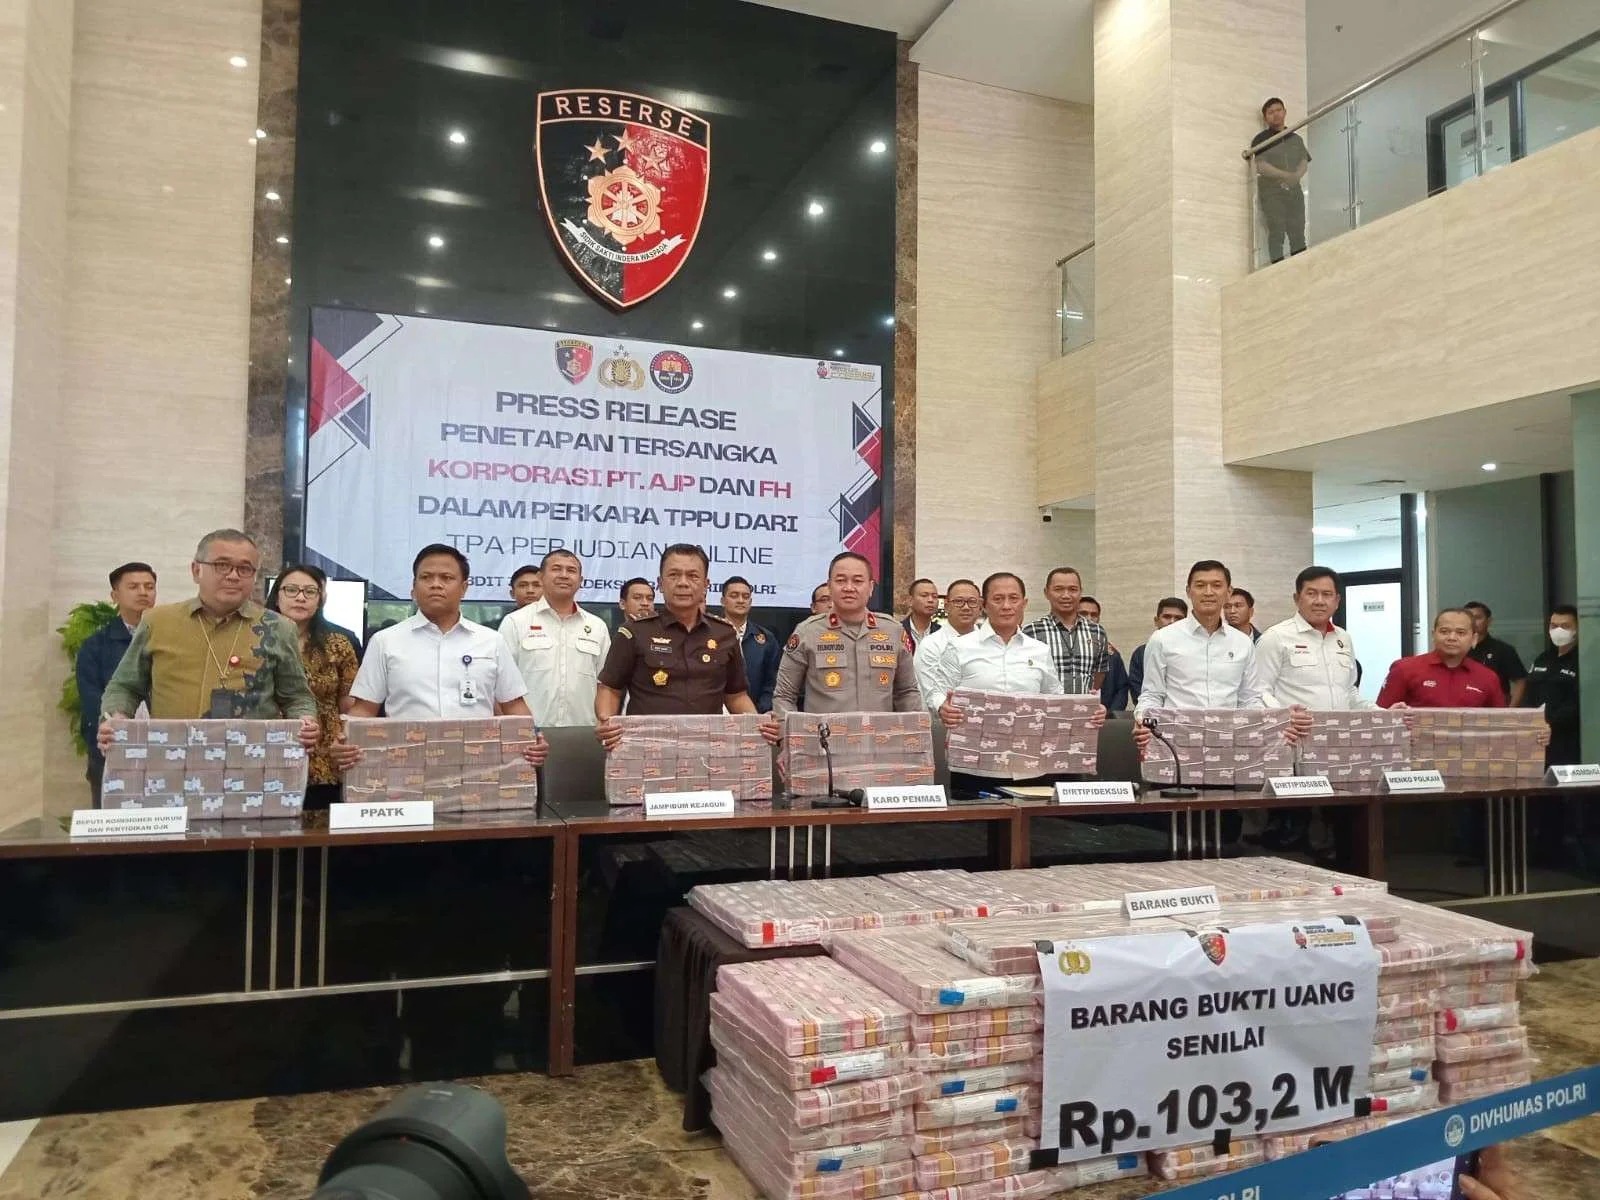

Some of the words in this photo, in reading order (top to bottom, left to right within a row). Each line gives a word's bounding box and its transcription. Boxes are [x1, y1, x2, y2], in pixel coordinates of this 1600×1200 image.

[555, 96, 693, 137] RESERSE
[580, 231, 596, 248] SIDIK
[596, 243, 615, 260] SAKTI
[639, 243, 668, 260] WASPADA
[496, 391, 600, 420] PRESS
[605, 400, 737, 431] RELEASE
[440, 422, 614, 453] PENETAPAN
[618, 435, 778, 465] TERSANGKA
[428, 458, 603, 487] KORPORASI
[606, 470, 645, 490] PT.
[649, 473, 695, 492] AJP
[699, 476, 755, 497] DAN
[759, 480, 792, 499] FH
[418, 495, 526, 520] DALAM
[531, 501, 660, 526] PERKARA
[663, 508, 730, 530] TPPU
[734, 511, 799, 533] DARI
[446, 533, 505, 555] TPA
[360, 807, 405, 818] PPATK
[872, 796, 900, 804] KARO
[902, 794, 942, 803] PENMAS
[1130, 897, 1178, 911] BARANG
[1180, 894, 1215, 907] BUKTI
[1070, 996, 1188, 1030] BARANG
[1198, 987, 1276, 1017] BUKTI
[1284, 981, 1355, 1008] UANG
[1166, 1026, 1265, 1060] SENILAI
[1312, 1065, 1355, 1111] M
[1470, 1094, 1544, 1134] DIVHUMAS
[1546, 1082, 1586, 1110] POLRI
